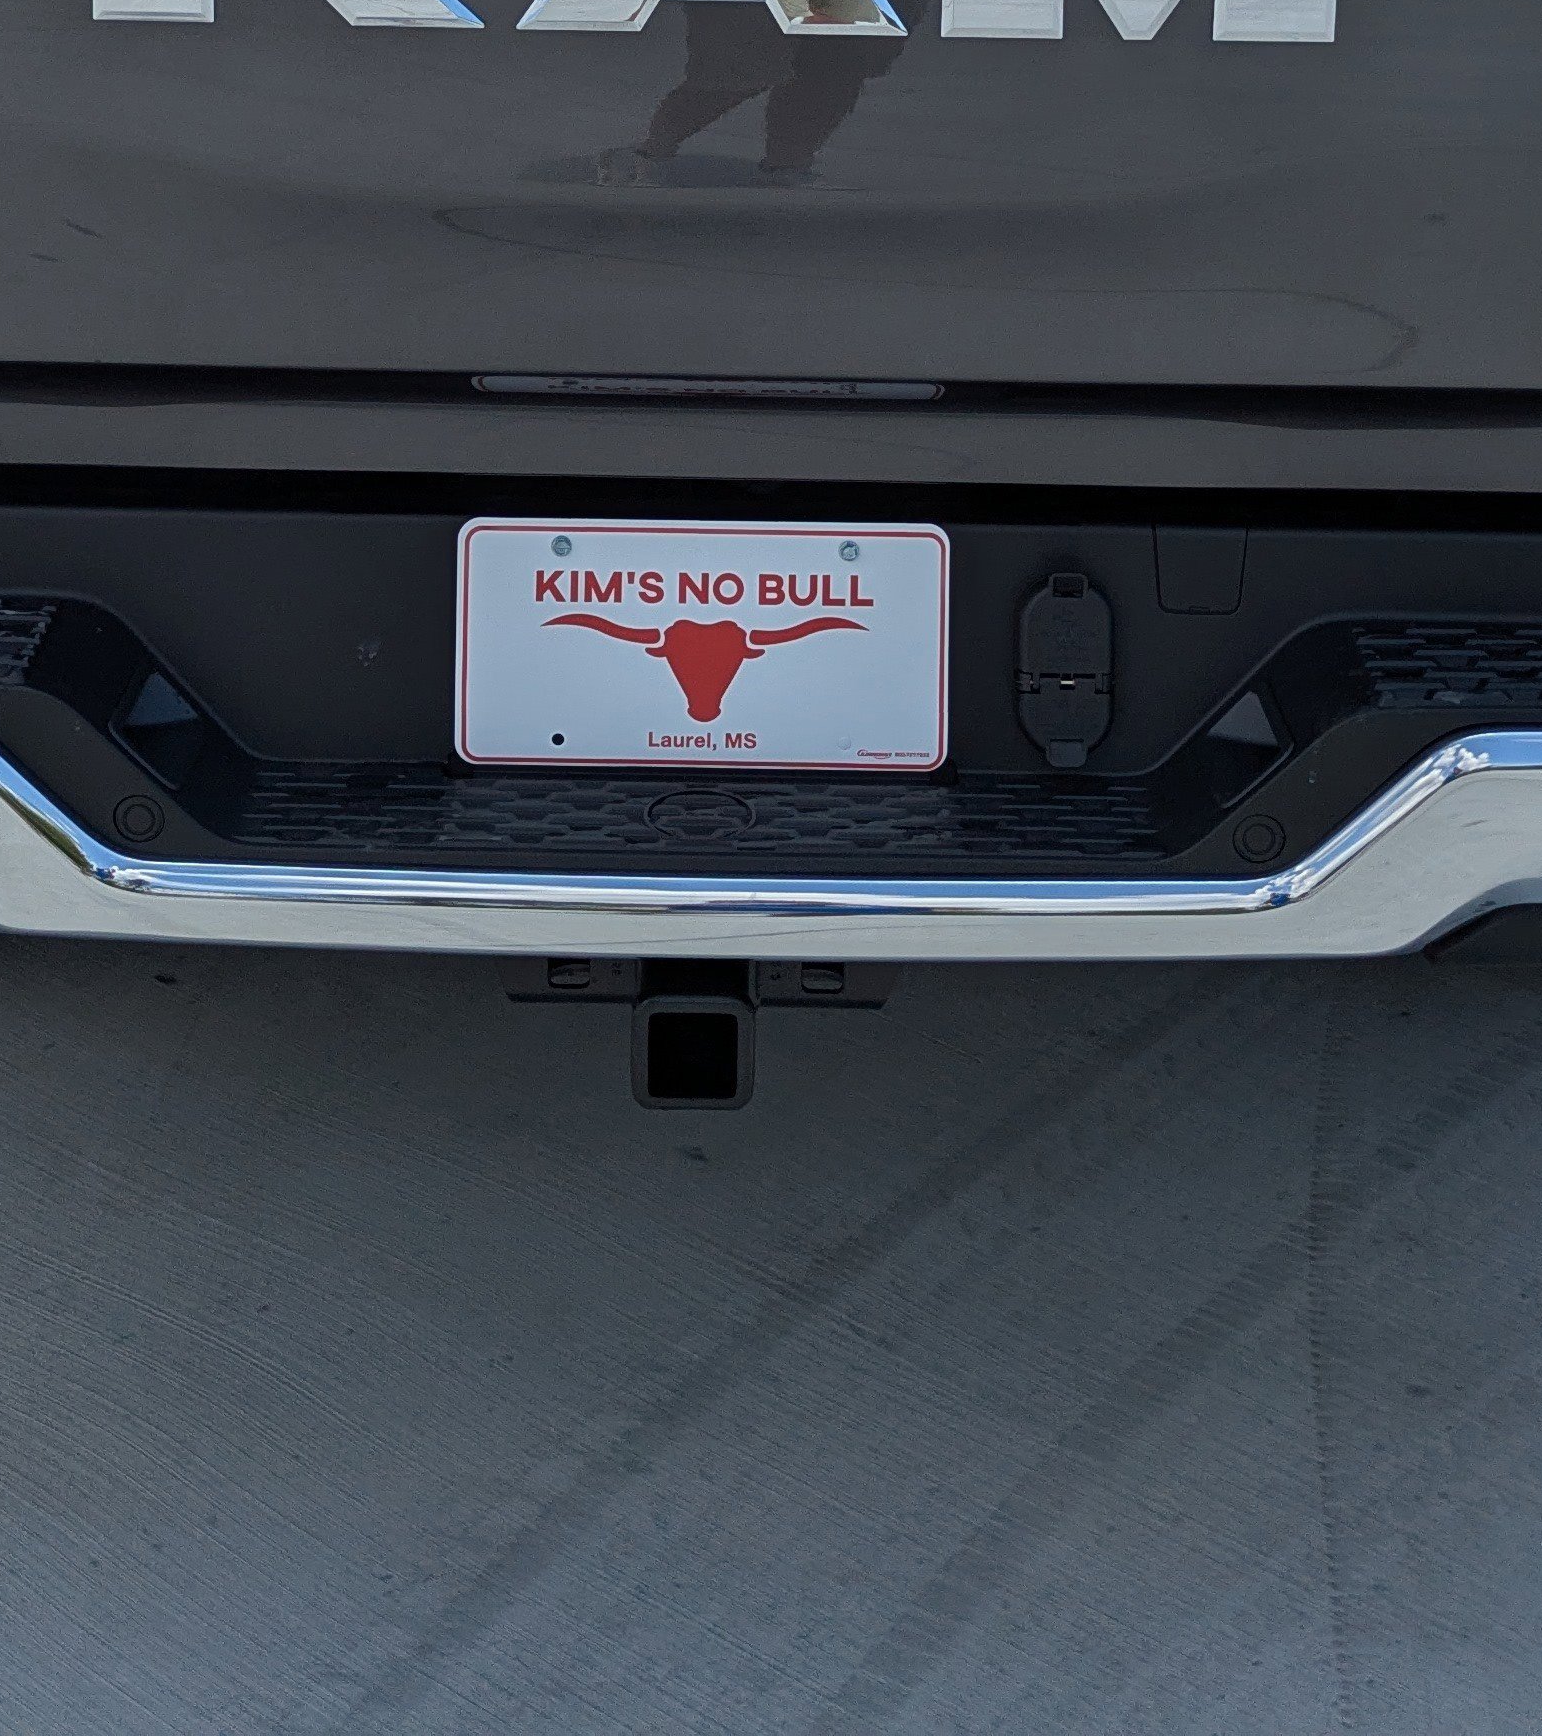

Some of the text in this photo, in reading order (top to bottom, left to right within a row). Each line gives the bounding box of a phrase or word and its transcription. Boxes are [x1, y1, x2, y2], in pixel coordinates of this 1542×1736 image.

[535, 570, 875, 607] KIM'S NO BULL
[648, 731, 757, 751] Laurel, MS
